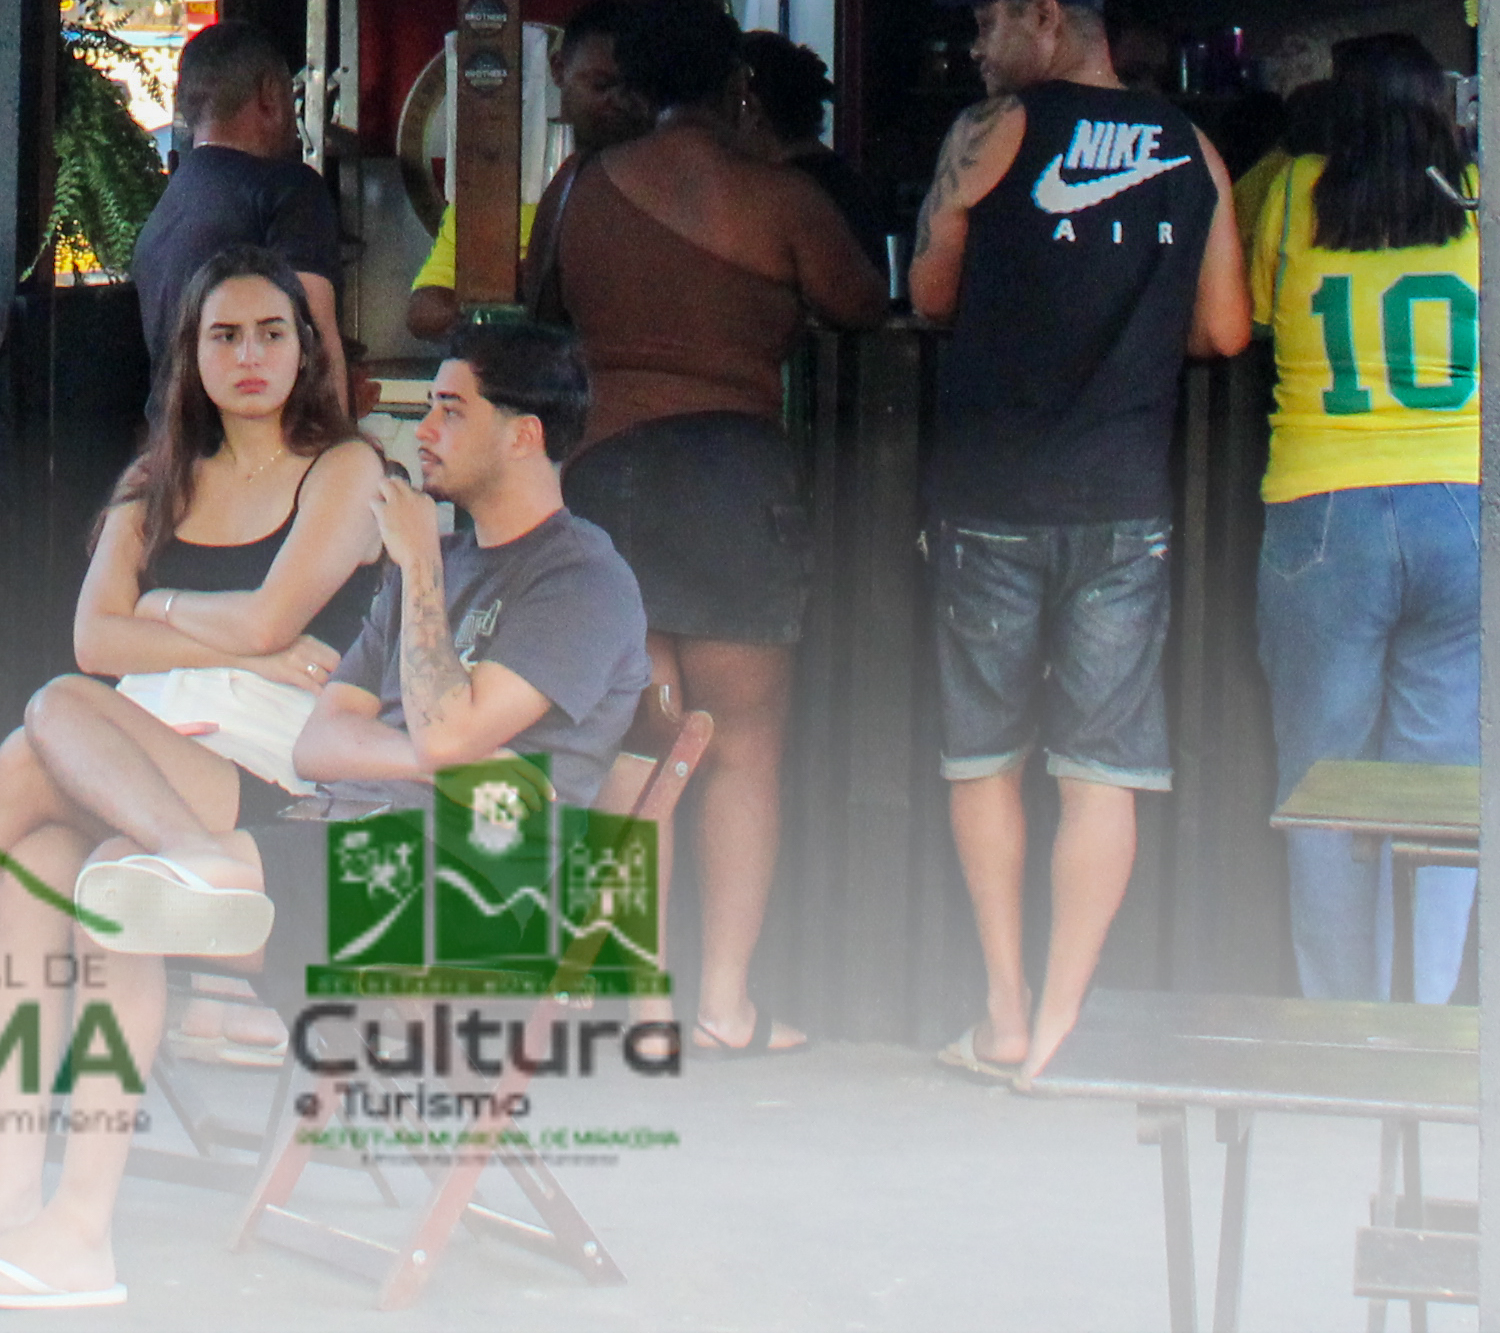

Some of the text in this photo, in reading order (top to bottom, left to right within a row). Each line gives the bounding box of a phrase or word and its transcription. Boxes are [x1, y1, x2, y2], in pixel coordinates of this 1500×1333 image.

[1066, 118, 1163, 170] NIKE
[1053, 217, 1174, 245] AIR
[1311, 273, 1480, 415] 10
